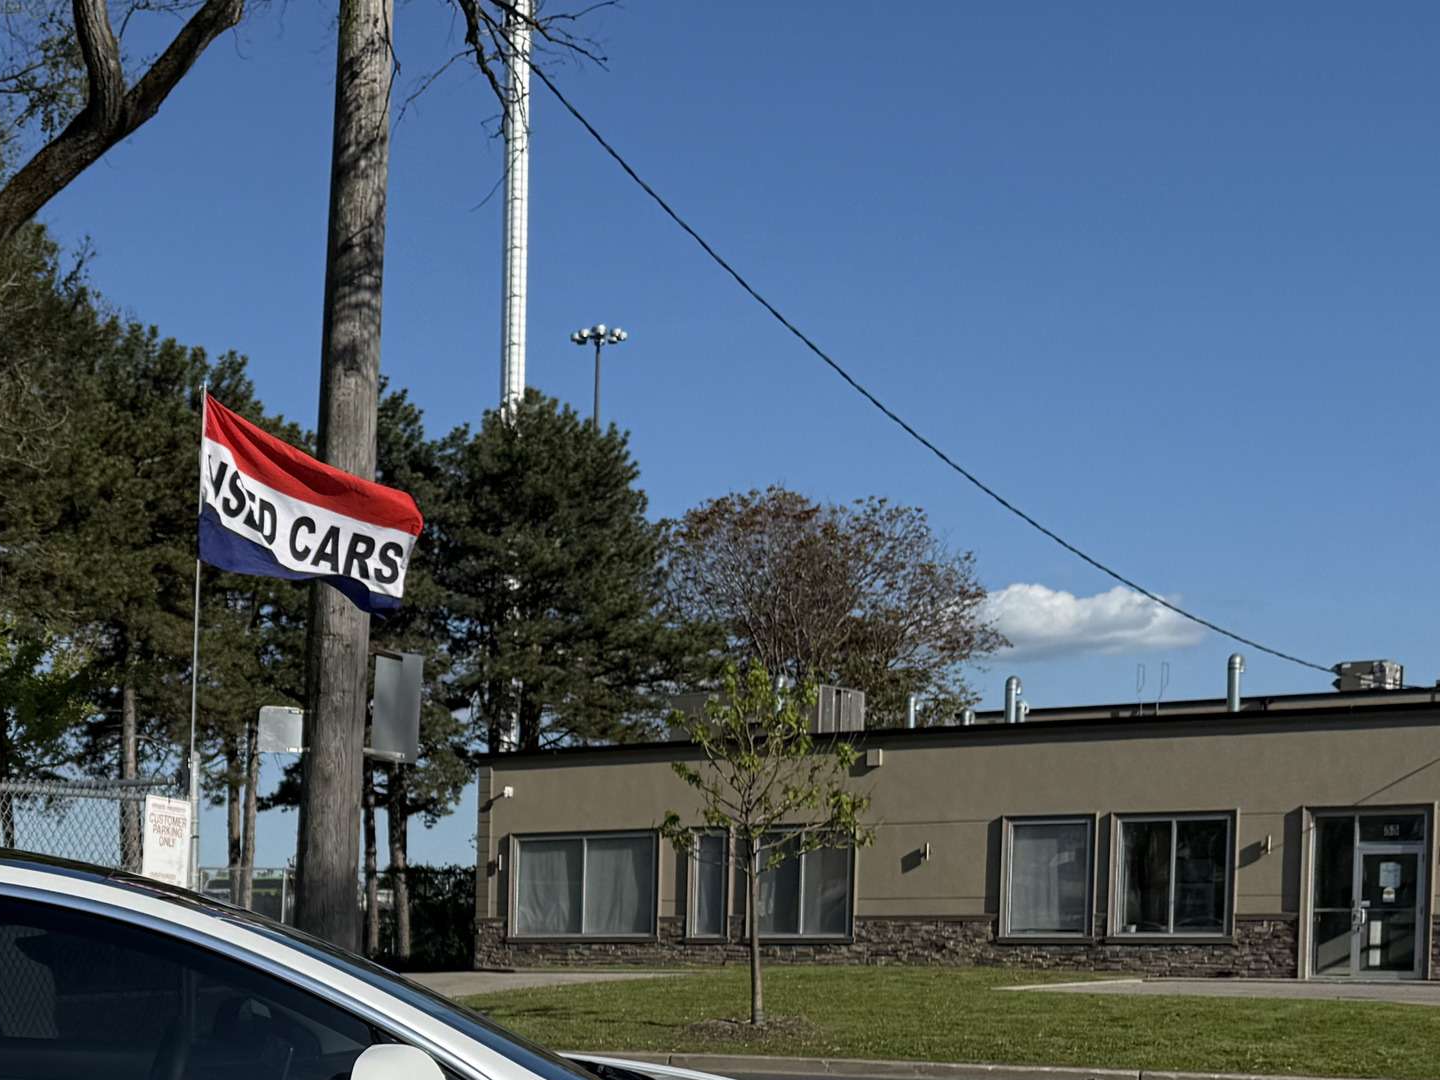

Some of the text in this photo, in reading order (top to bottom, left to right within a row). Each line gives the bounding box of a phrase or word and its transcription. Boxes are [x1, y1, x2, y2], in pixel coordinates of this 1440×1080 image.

[289, 516, 404, 584] CARS
[149, 813, 187, 830] CUSTOMER
[152, 824, 183, 839] PARKING
[159, 837, 176, 848] ONLY
